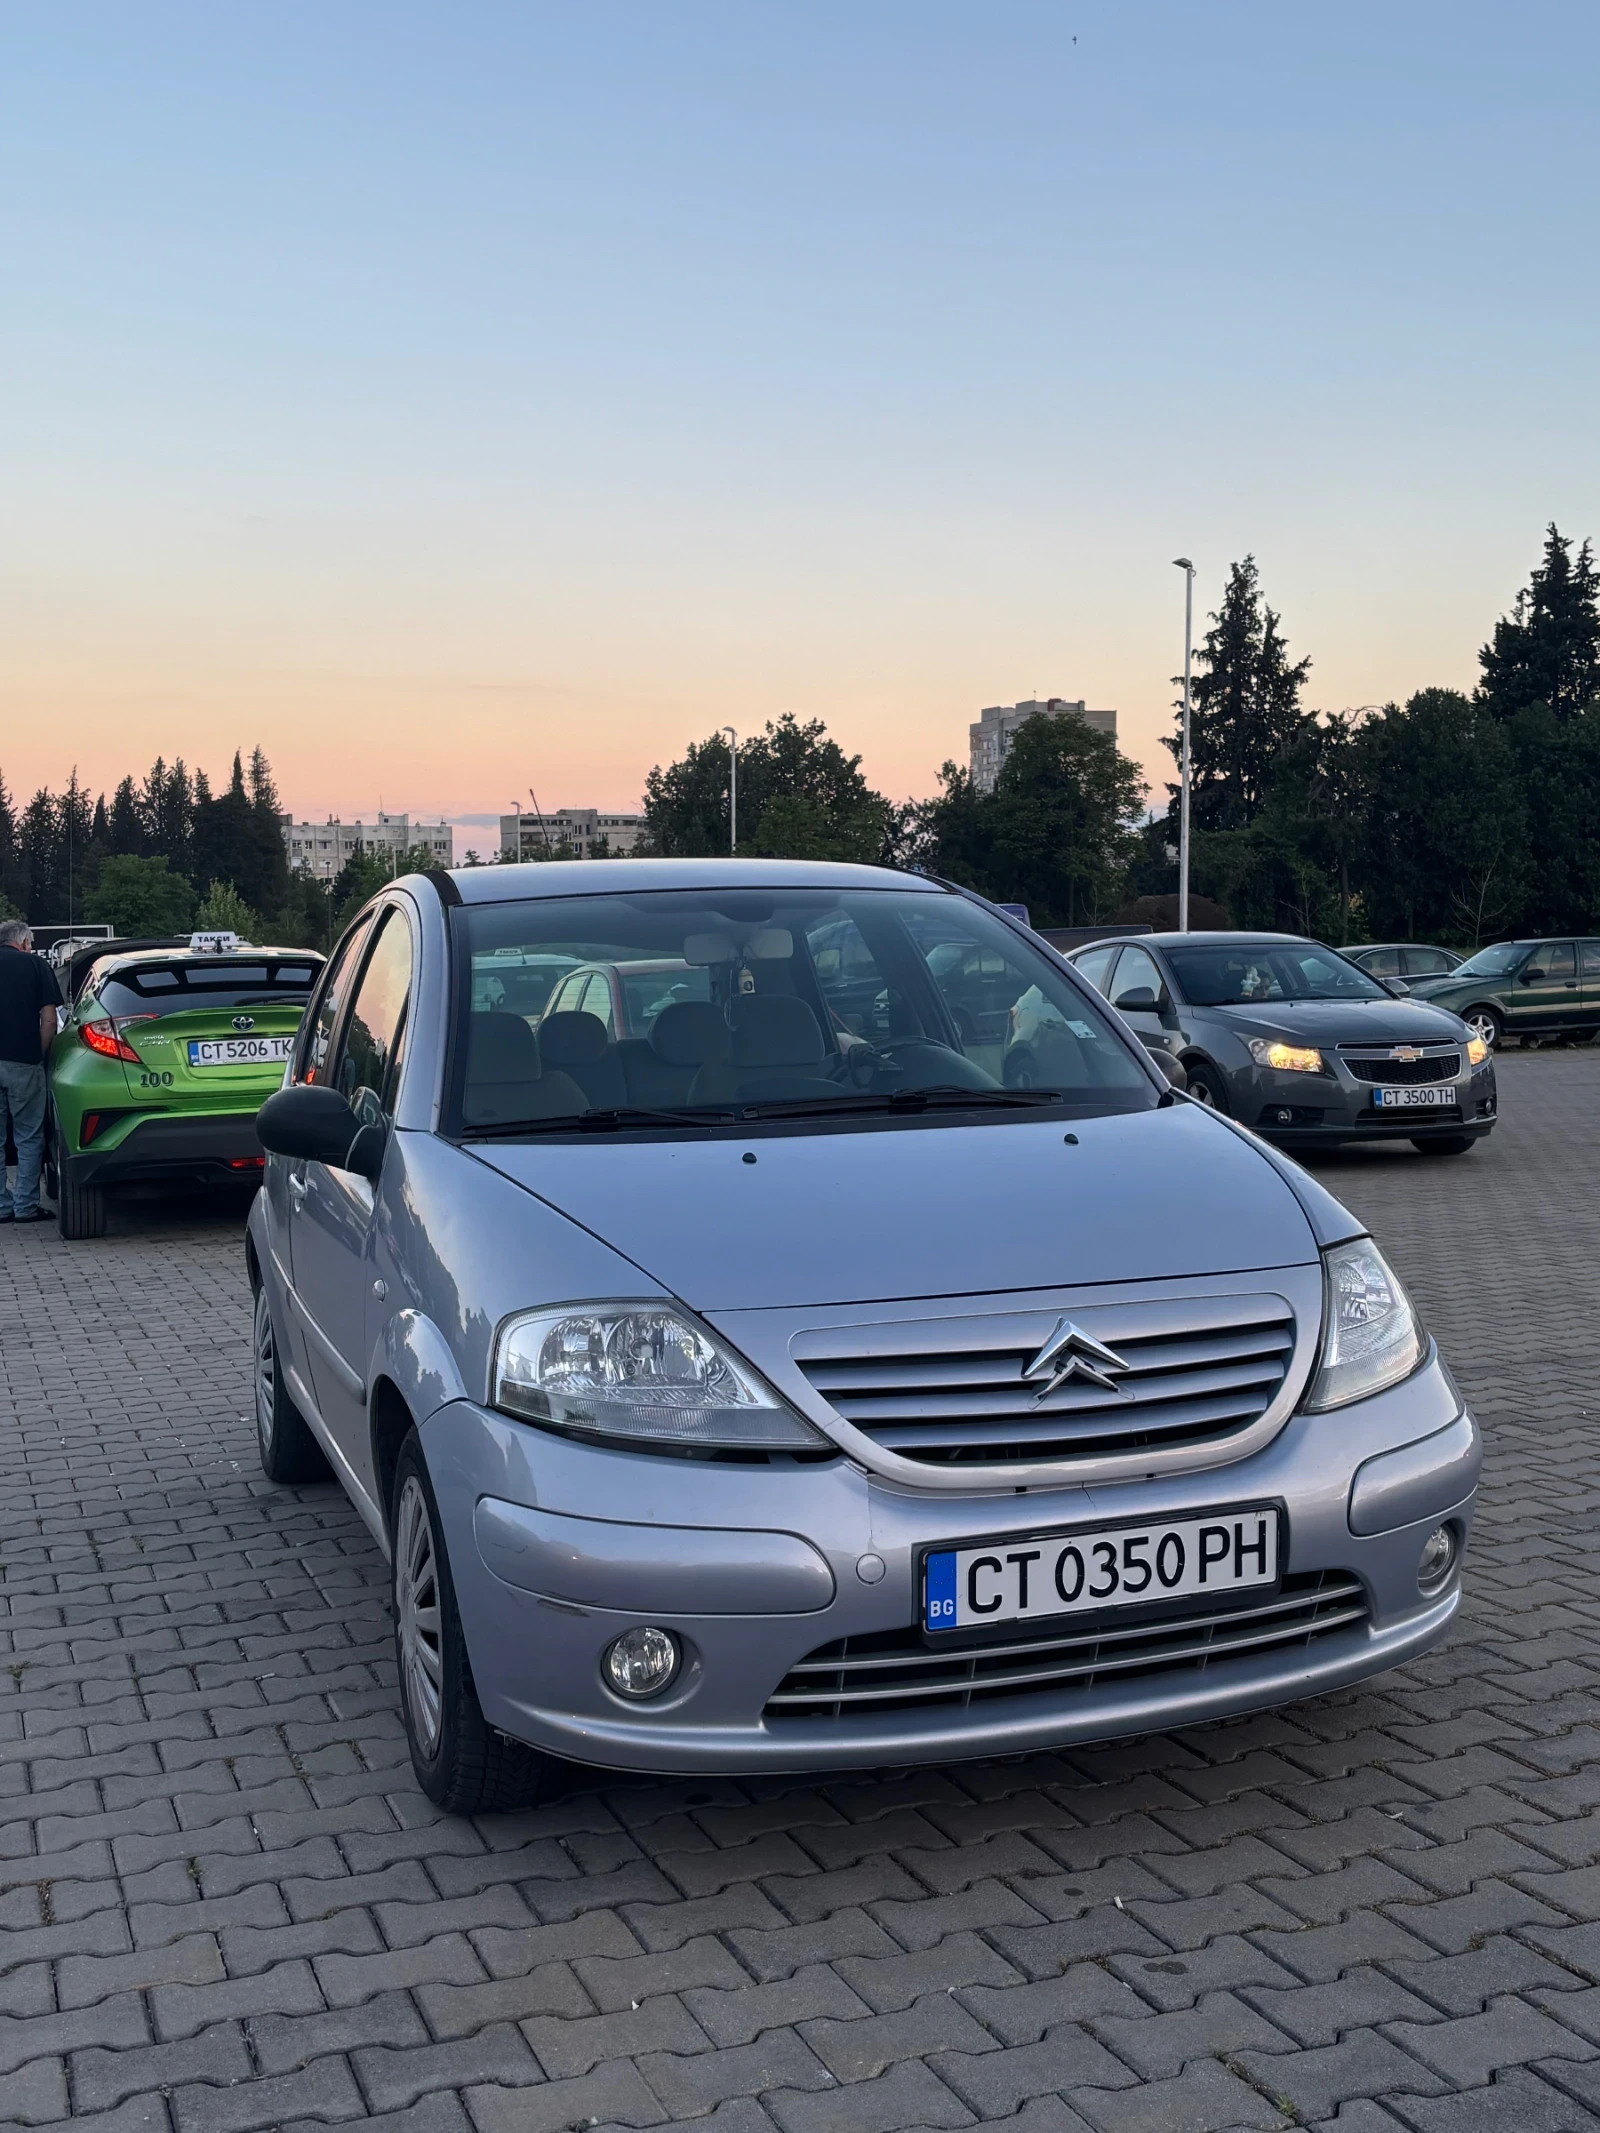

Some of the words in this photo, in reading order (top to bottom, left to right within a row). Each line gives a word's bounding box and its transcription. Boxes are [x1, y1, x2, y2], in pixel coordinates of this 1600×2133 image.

[201, 1043, 223, 1059] CT
[226, 1040, 268, 1058] 5206
[140, 1071, 174, 1088] 100
[1384, 1091, 1401, 1105] CT
[1404, 1090, 1435, 1104] 3500
[1437, 1089, 1454, 1103] TH
[967, 1551, 1040, 1614] CT
[1054, 1532, 1185, 1603] 0350
[1199, 1520, 1266, 1583] PH
[930, 1599, 954, 1618] BG
